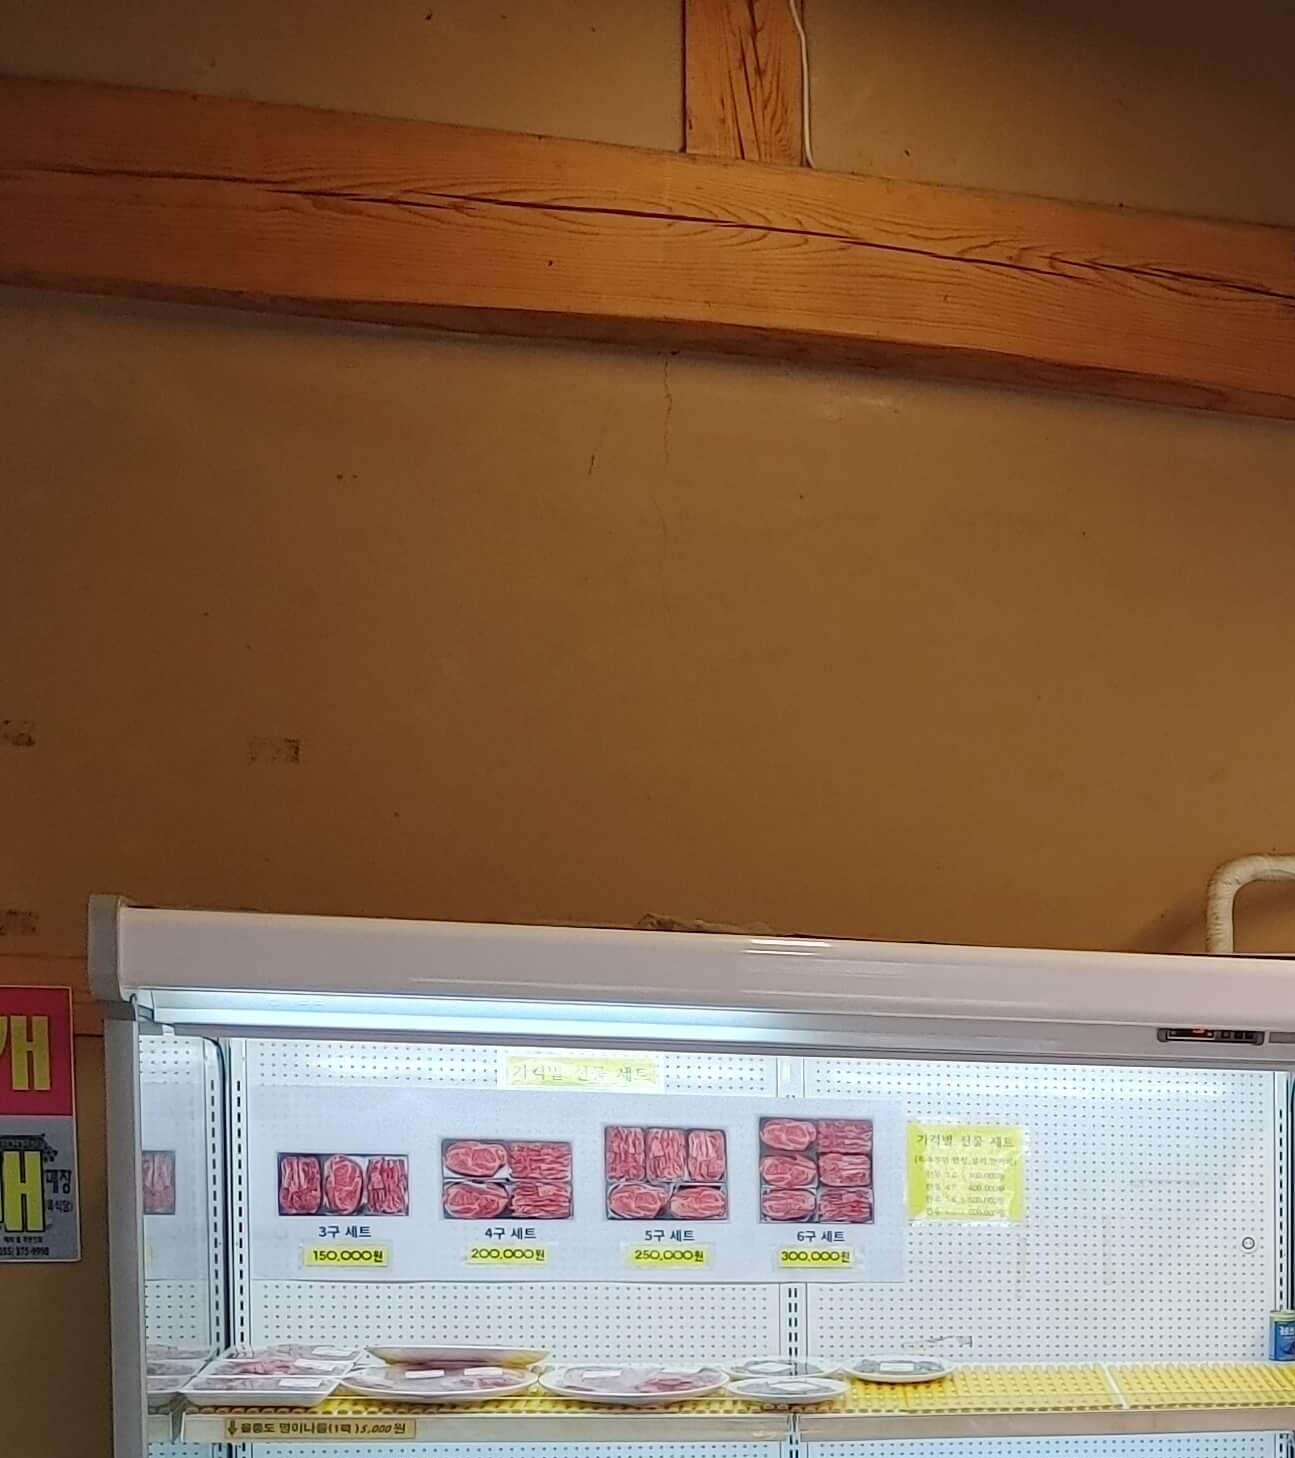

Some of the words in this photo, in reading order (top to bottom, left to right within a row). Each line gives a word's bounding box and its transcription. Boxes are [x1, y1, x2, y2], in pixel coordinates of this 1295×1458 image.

[318, 1225, 340, 1239] 3구
[345, 1225, 372, 1239] 세트
[484, 1227, 505, 1239] 4구
[511, 1227, 537, 1240] 세트
[644, 1229, 666, 1242] 5구
[670, 1229, 696, 1243] 세트
[796, 1230, 816, 1243] 6구
[821, 1230, 846, 1243] 세트
[312, 1249, 383, 1263] 150,000원
[471, 1248, 545, 1262] 200,000원
[634, 1249, 704, 1263] 250,000원
[781, 1250, 851, 1264] 300,000원
